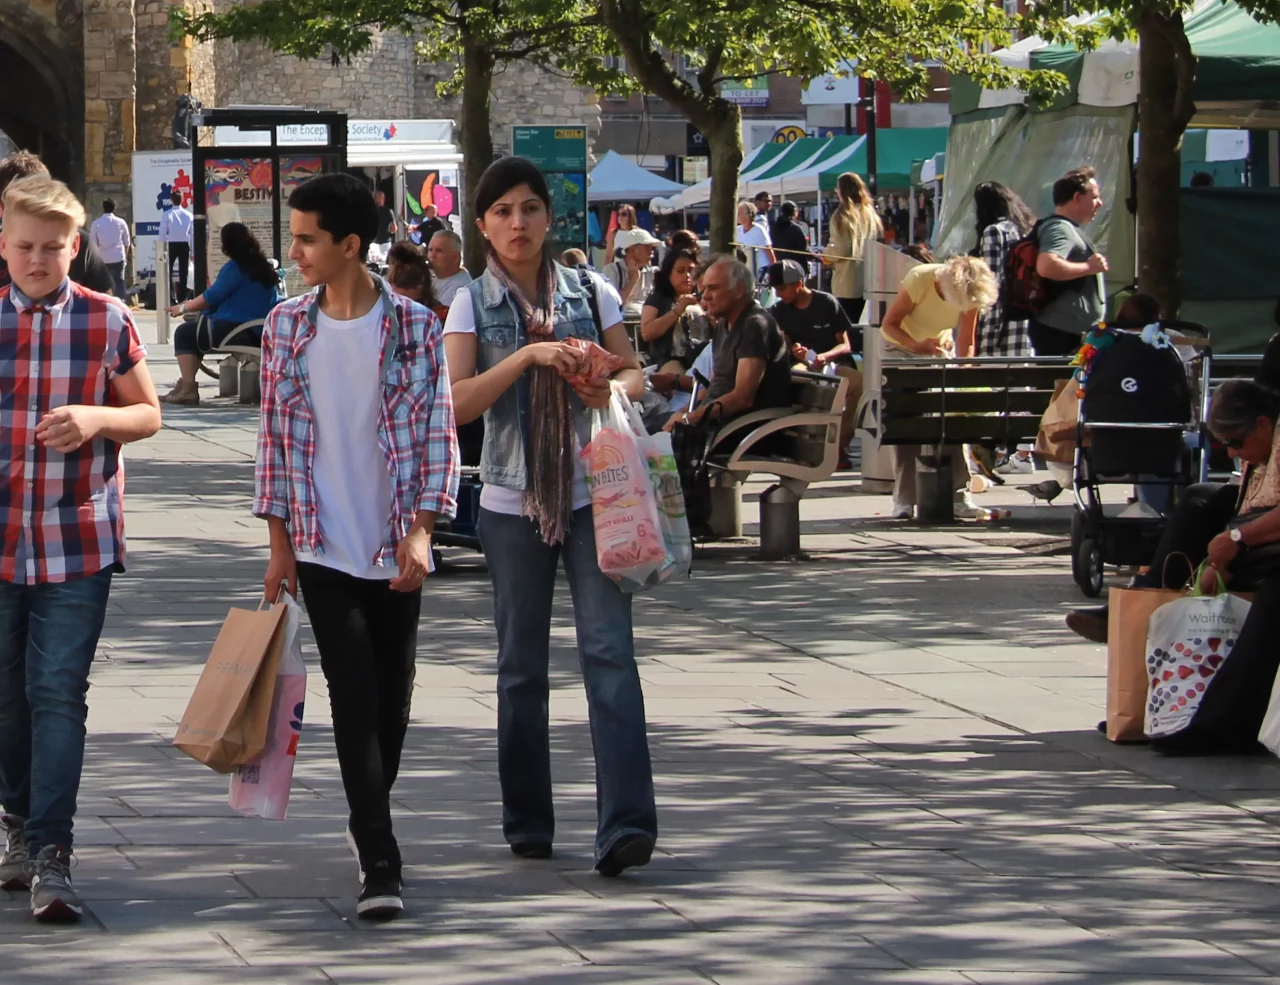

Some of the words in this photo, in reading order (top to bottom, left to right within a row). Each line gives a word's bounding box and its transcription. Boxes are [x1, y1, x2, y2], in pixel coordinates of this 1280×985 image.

[282, 125, 297, 135] The
[352, 124, 382, 136] Society
[234, 188, 289, 201] BESTIVL
[636, 523, 646, 538] 6
[1188, 612, 1237, 626] Waitrose
